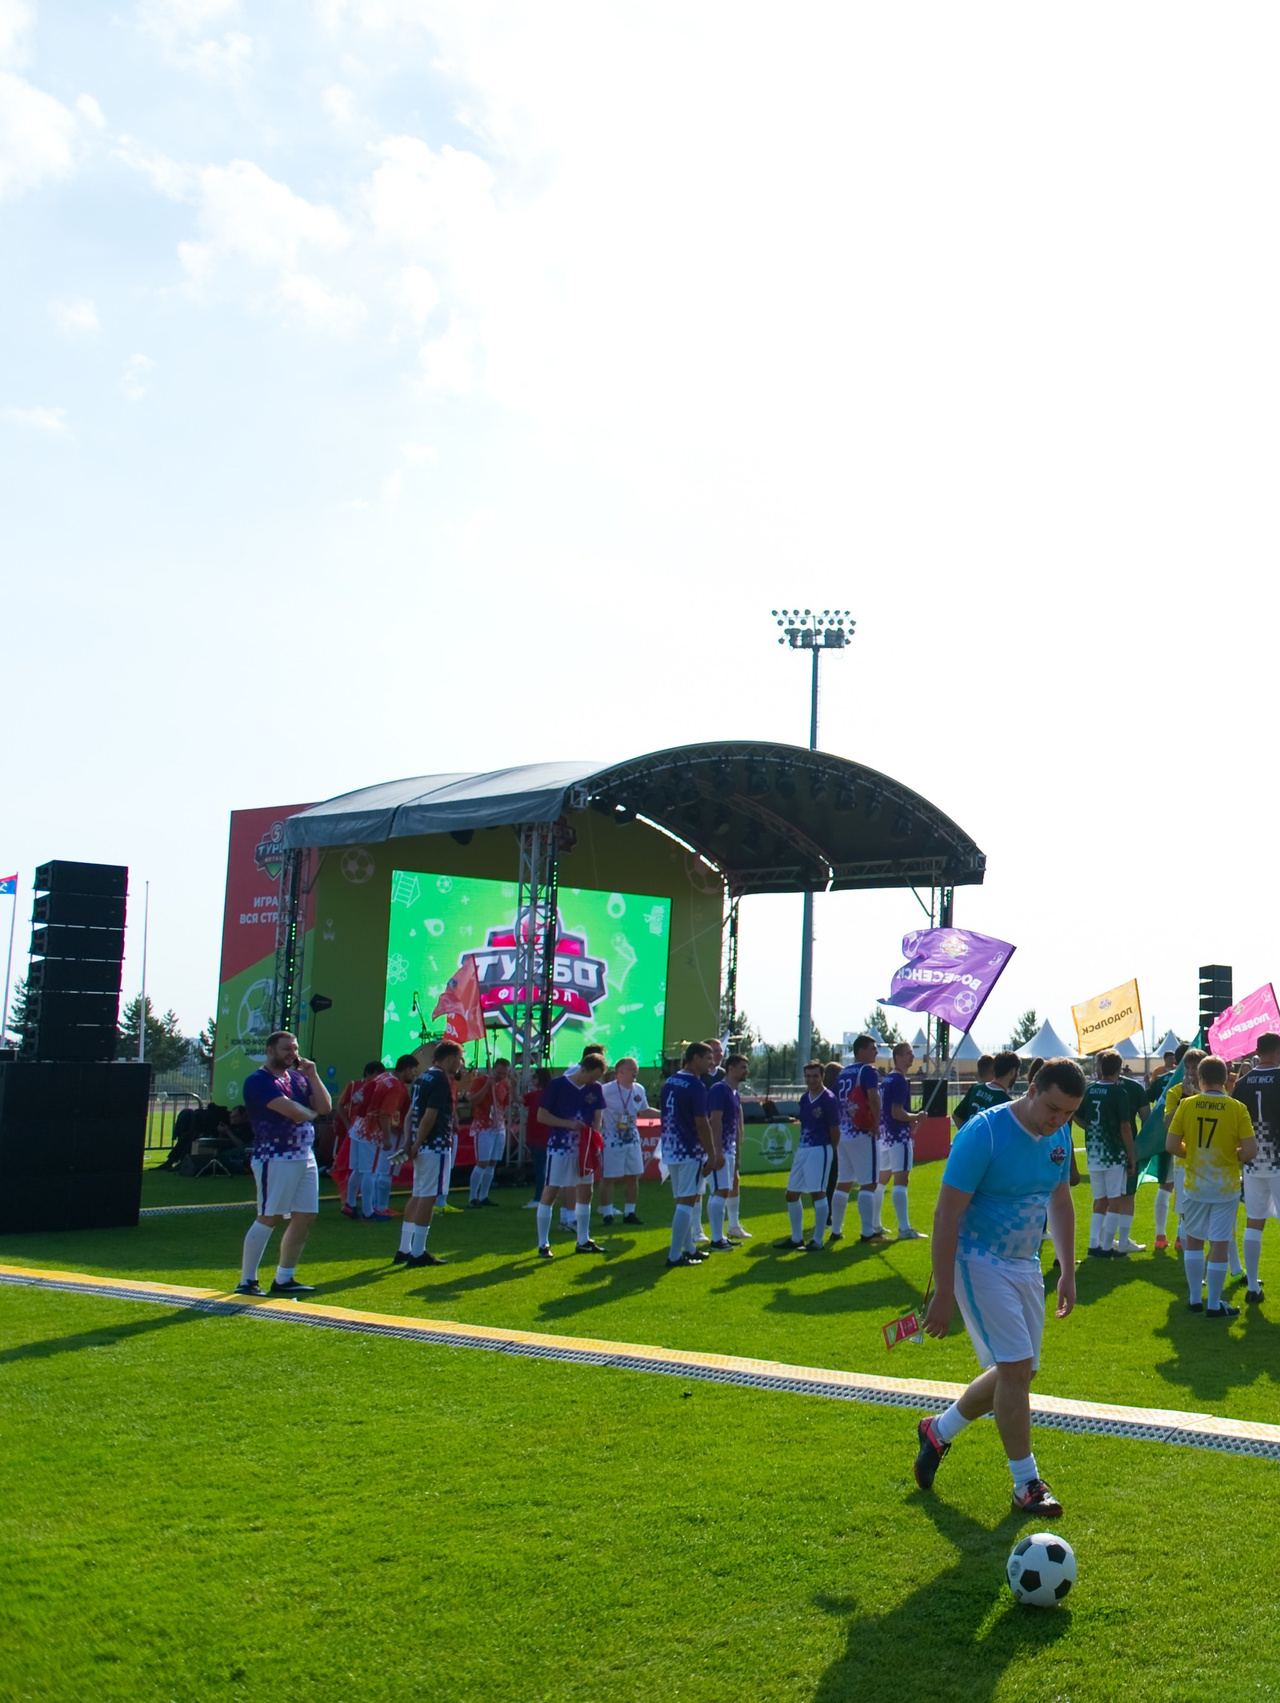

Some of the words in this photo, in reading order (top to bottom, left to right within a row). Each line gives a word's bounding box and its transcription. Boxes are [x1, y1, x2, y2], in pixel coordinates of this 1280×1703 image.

[259, 844, 284, 855] ТУР
[254, 896, 290, 907] ИГРАТ
[240, 913, 259, 924] ВСЯ
[1247, 1075, 1275, 1084] НОГИНСК
[1196, 1101, 1226, 1111] НОГИНСК
[1255, 1090, 1263, 1123] 1
[1091, 1100, 1101, 1126] 3
[1197, 1117, 1219, 1149] 17
